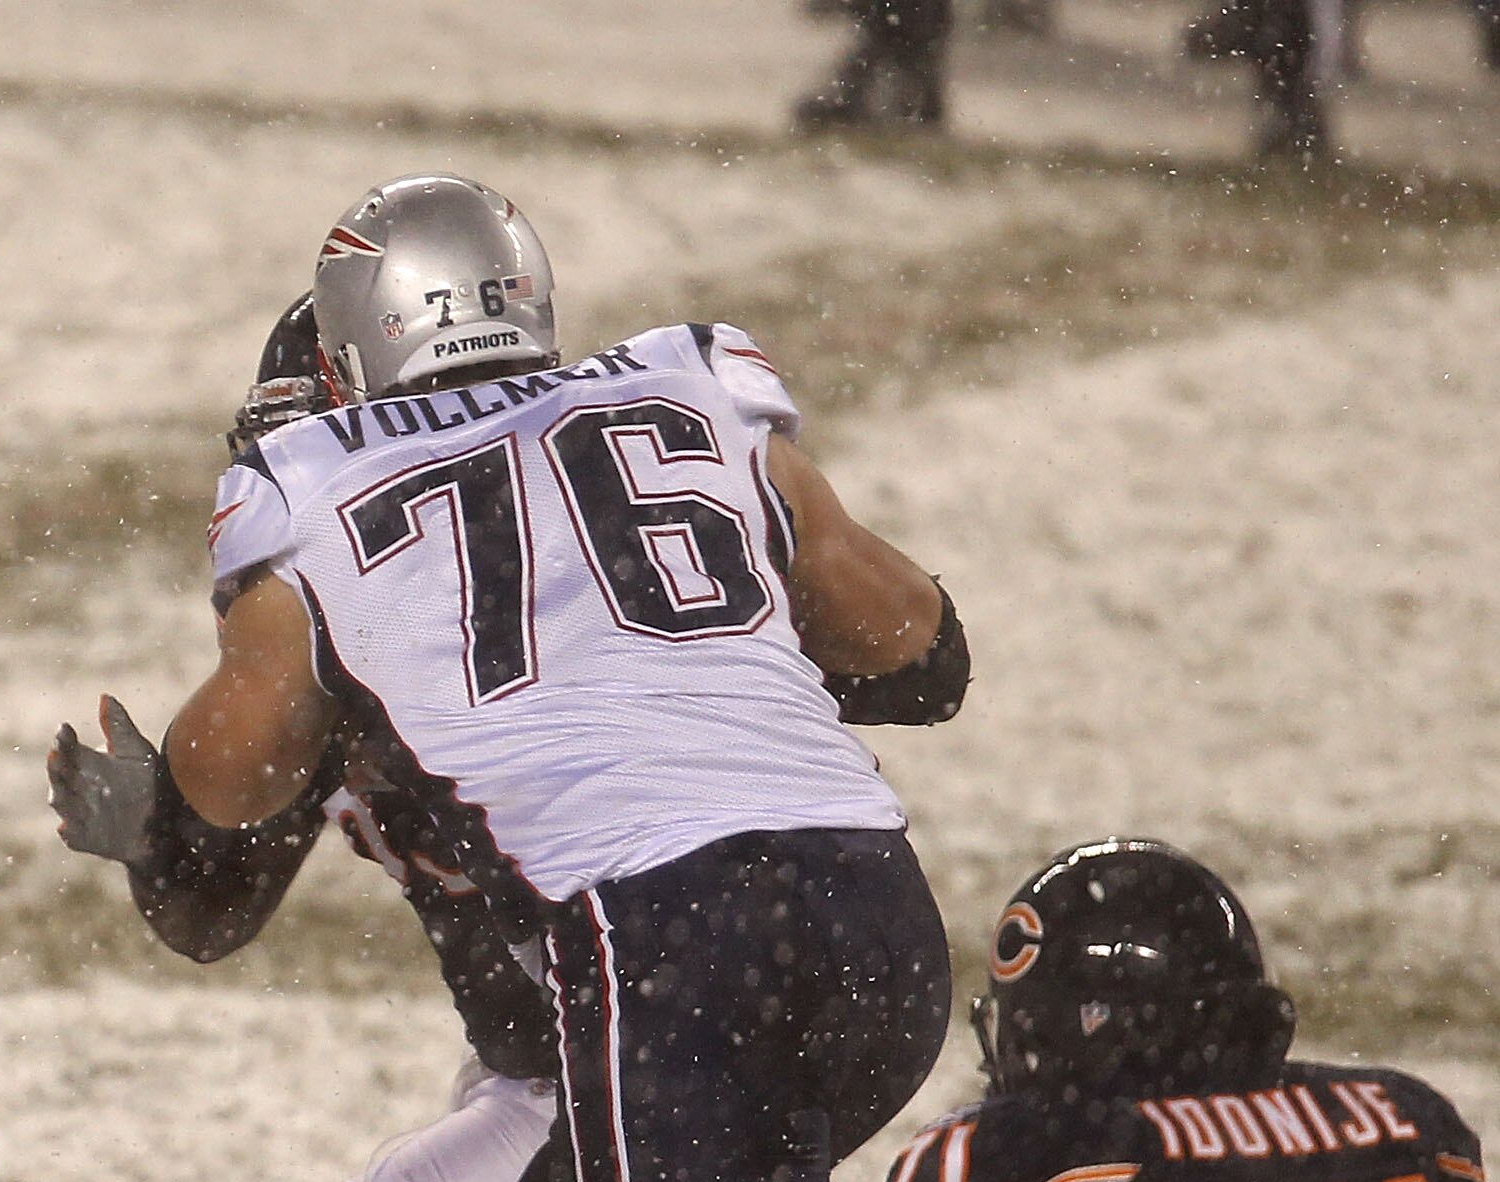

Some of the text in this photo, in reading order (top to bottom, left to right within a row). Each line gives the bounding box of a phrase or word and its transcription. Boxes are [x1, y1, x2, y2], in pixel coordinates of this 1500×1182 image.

[433, 331, 520, 358] PATRIOTS
[334, 396, 775, 707] 76
[1140, 1080, 1420, 1161] IDONIJE
